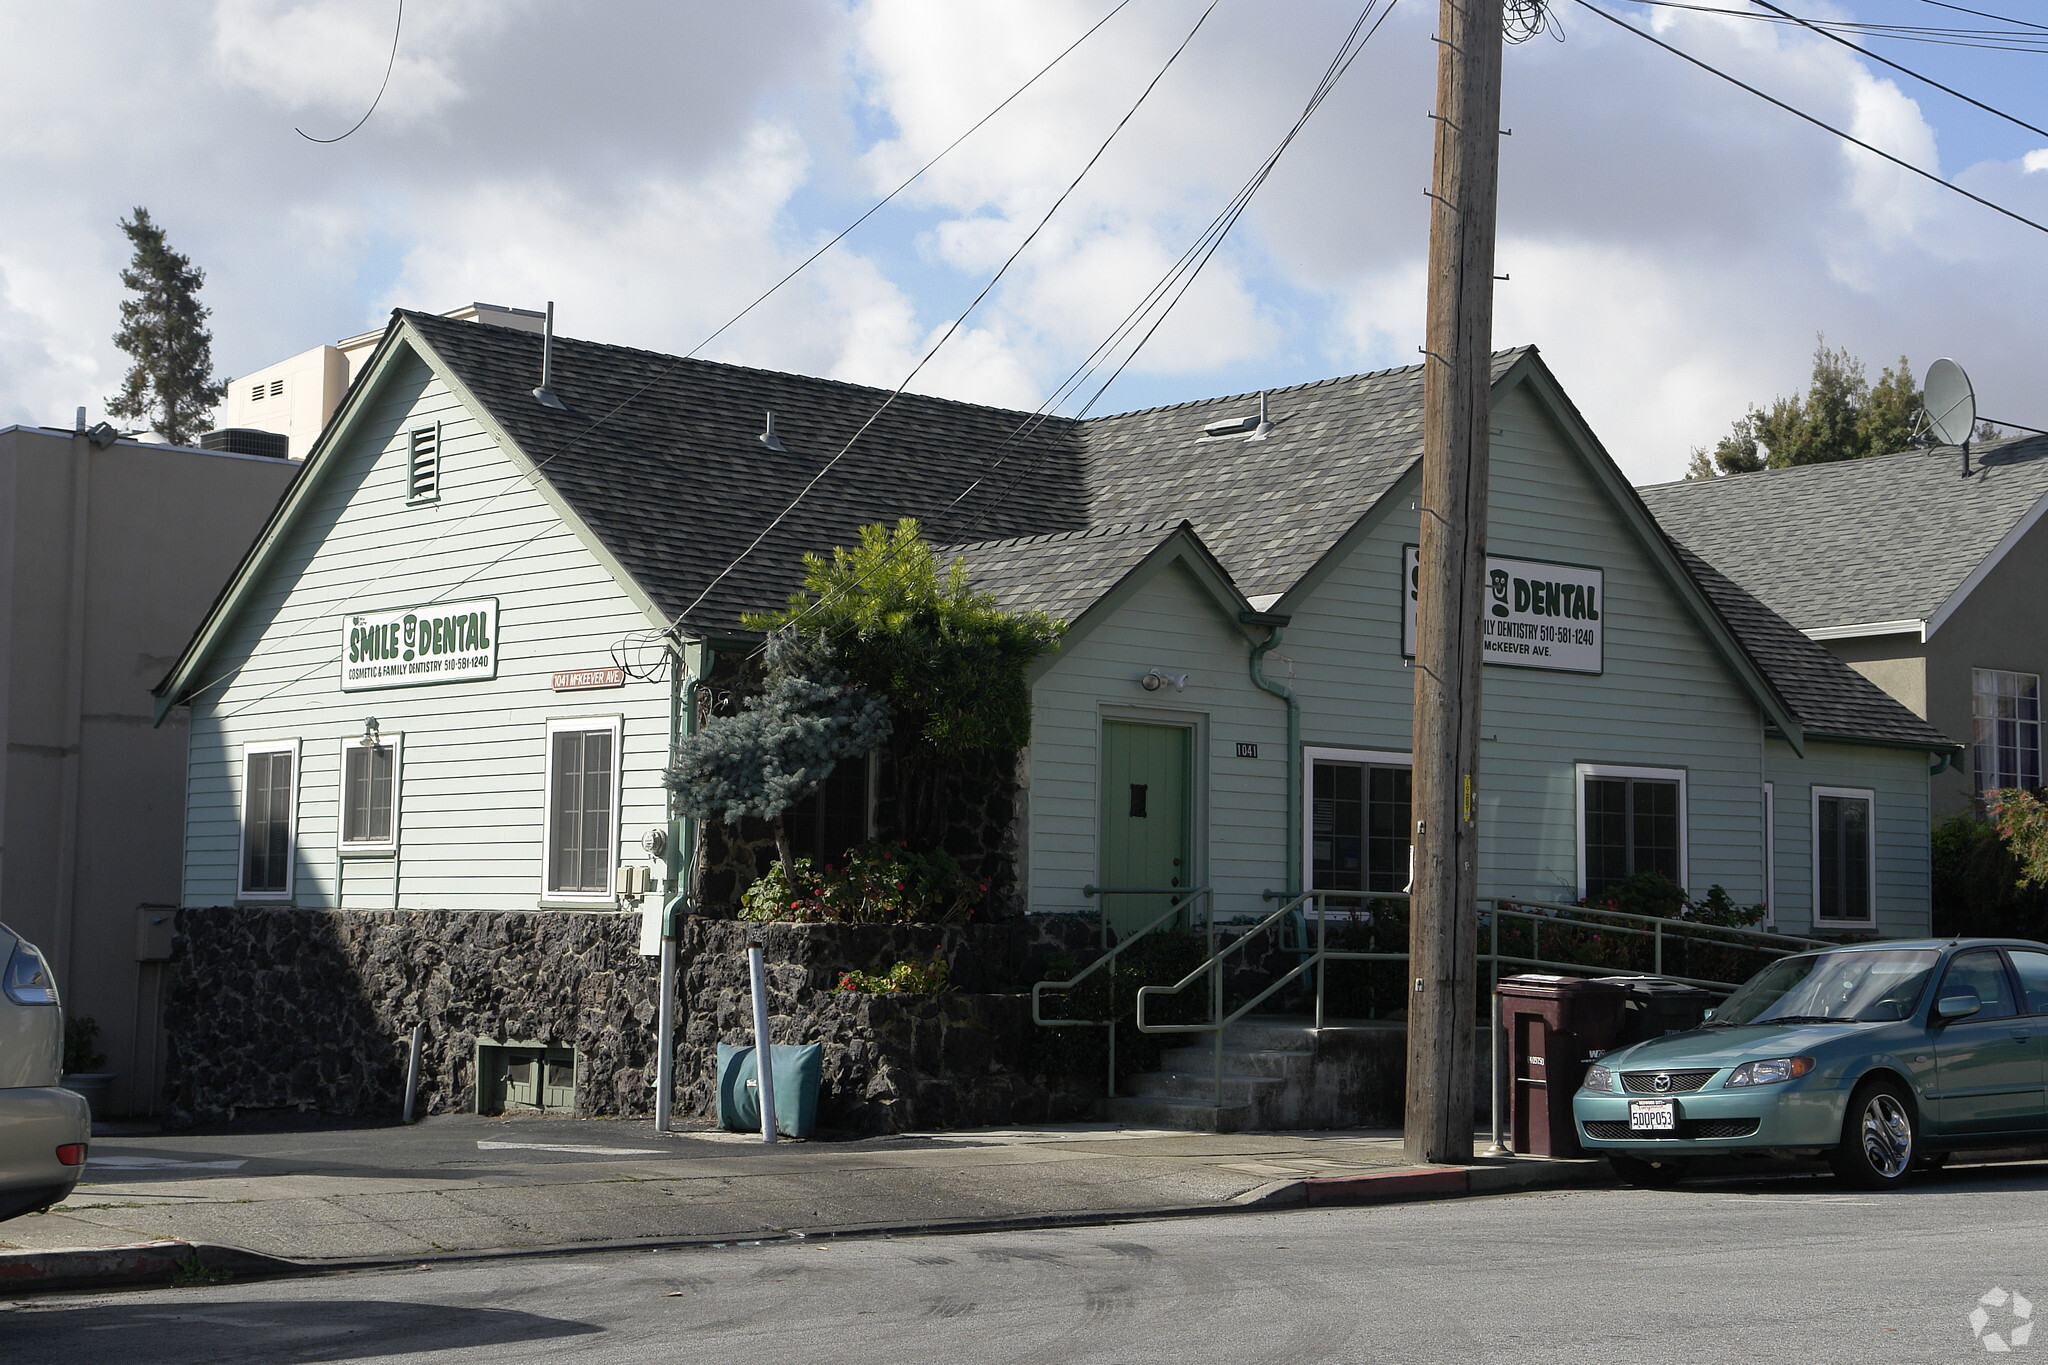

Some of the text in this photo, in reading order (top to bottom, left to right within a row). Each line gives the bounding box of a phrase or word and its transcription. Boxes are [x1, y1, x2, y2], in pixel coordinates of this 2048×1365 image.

[1513, 577, 1599, 621] DENTAL
[349, 611, 489, 663] SMILE DENTAL
[1497, 620, 1539, 640] DENTISTRY
[1540, 625, 1594, 646] 510-581-1240
[1484, 640, 1552, 657] McKEEVER AVE.
[349, 666, 377, 680] COSMETIC
[378, 666, 382, 677] &
[383, 664, 407, 677] FAMILY
[408, 660, 442, 675] DENTISTRY
[554, 674, 569, 687] 1041
[606, 670, 620, 683] AVE.
[1238, 744, 1257, 756] 1041
